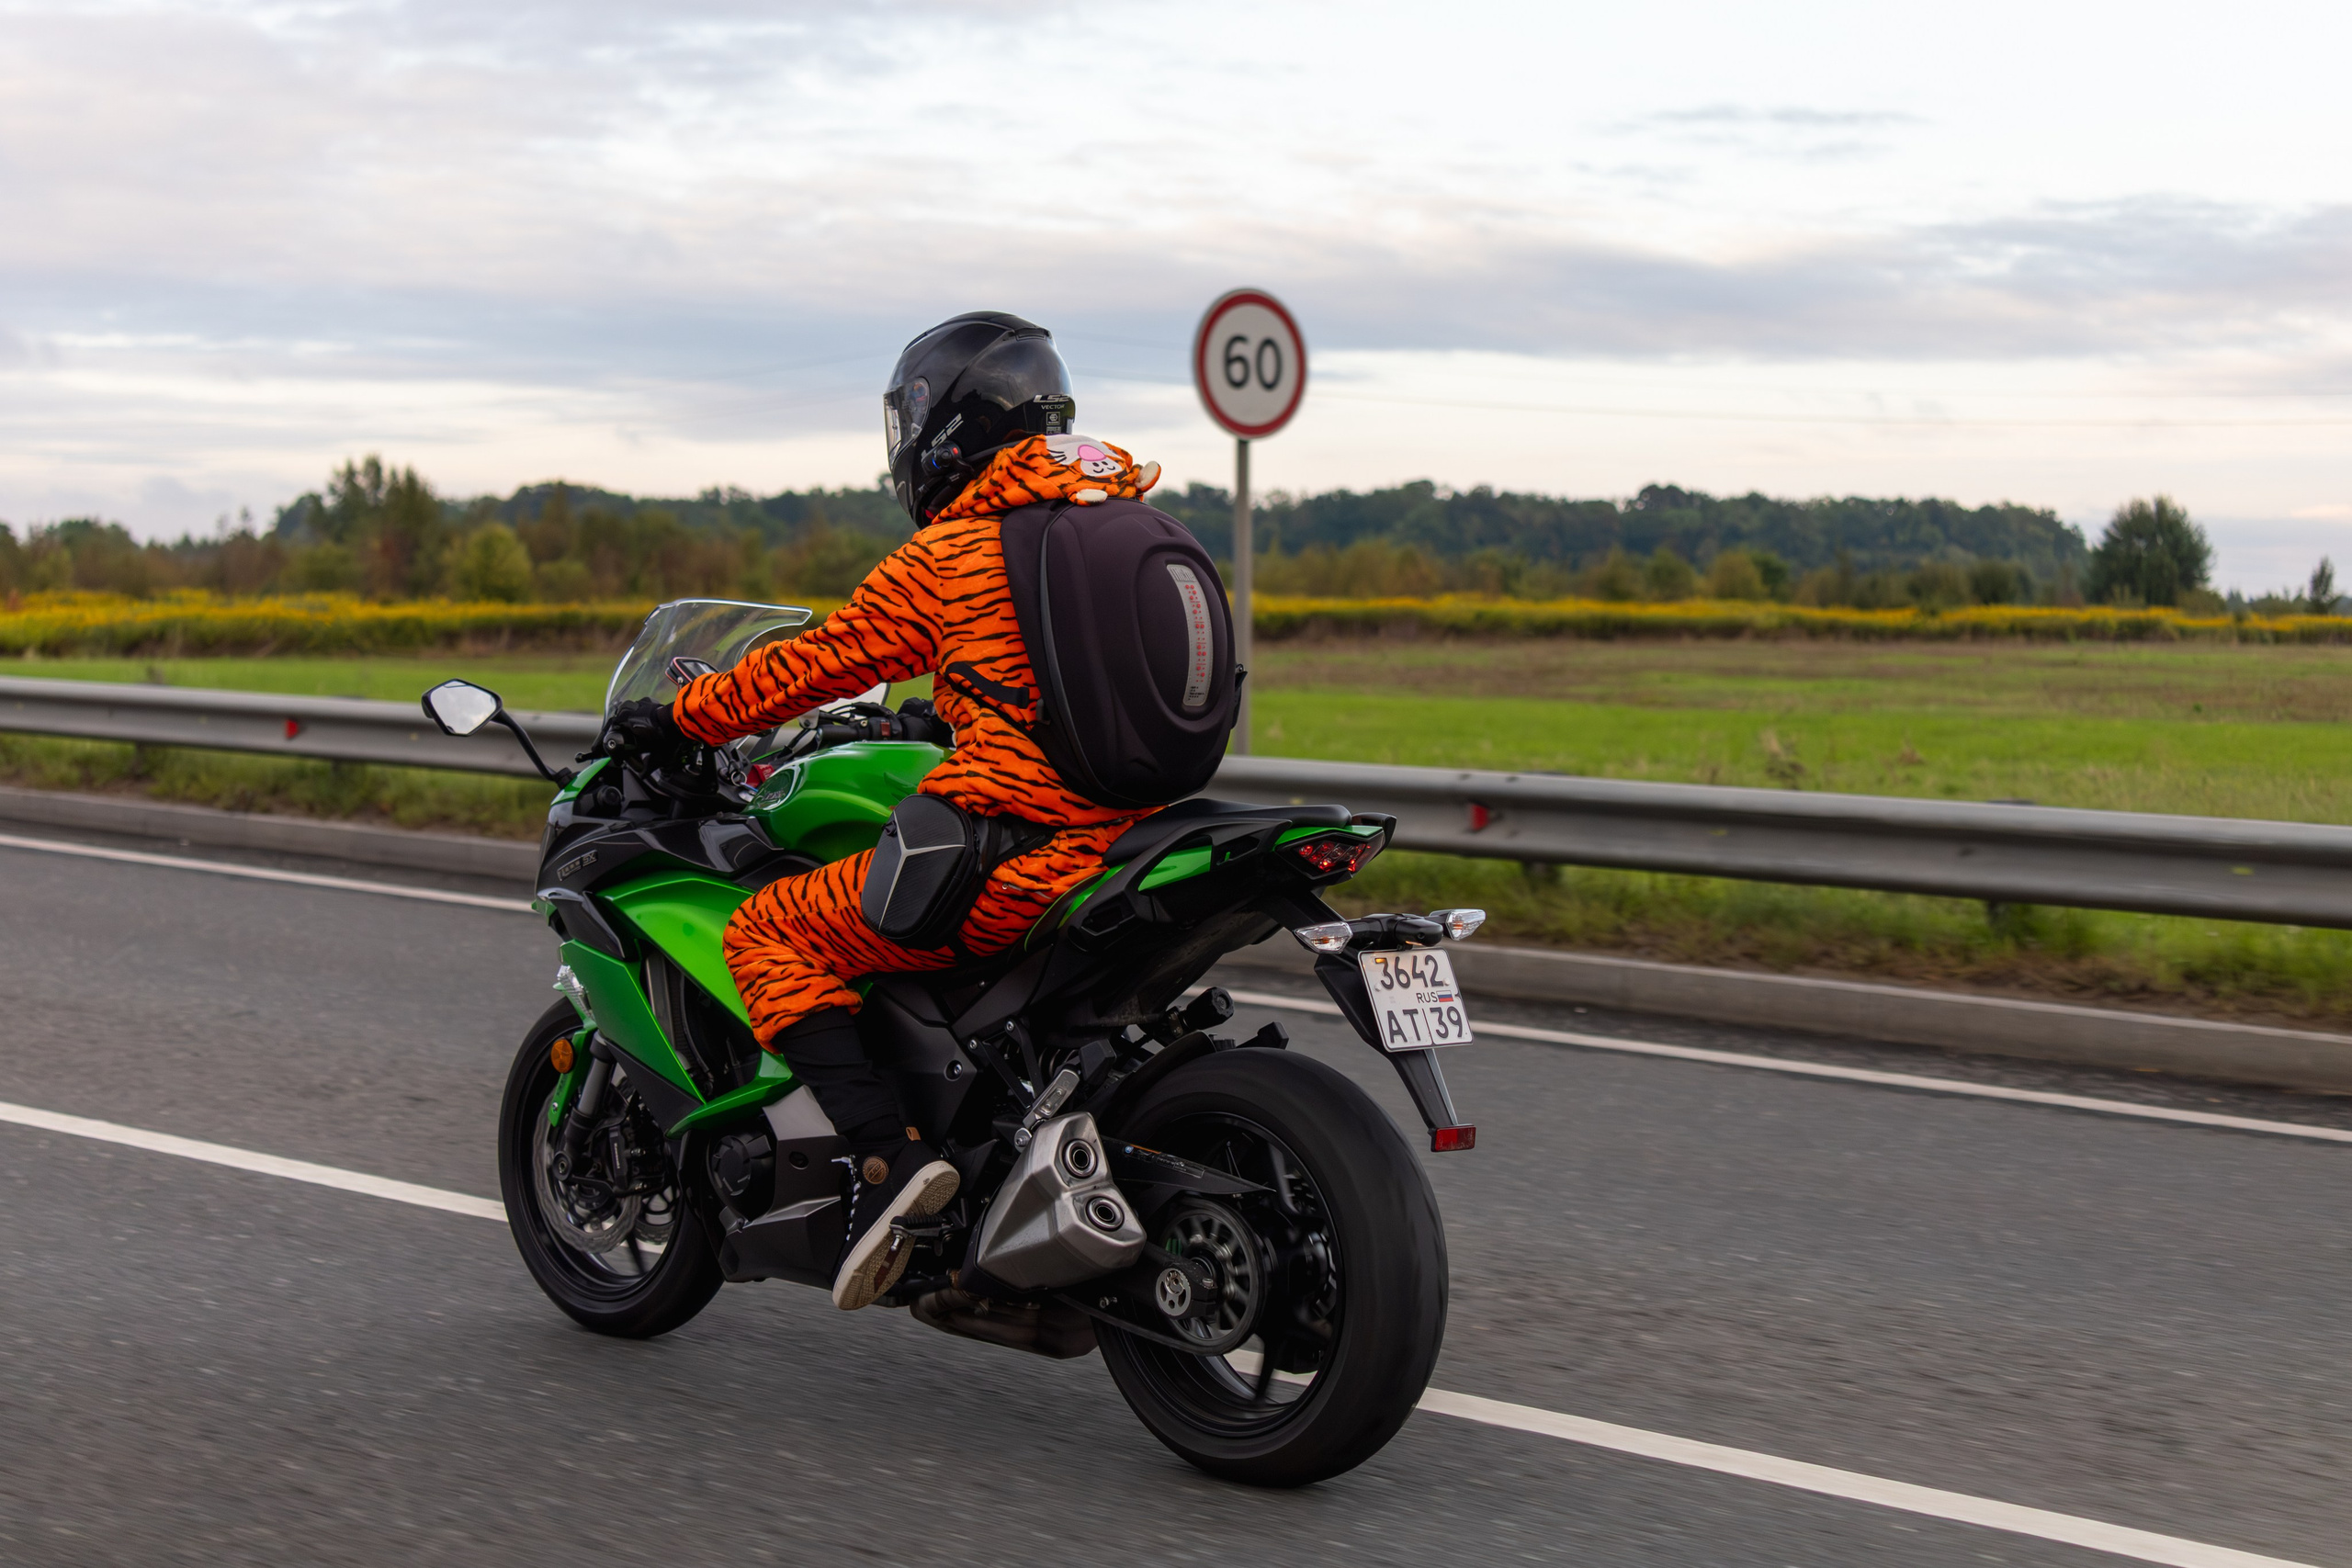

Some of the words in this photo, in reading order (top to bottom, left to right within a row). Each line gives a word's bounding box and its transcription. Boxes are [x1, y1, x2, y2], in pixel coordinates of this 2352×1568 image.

[1224, 334, 1283, 392] 60
[1033, 394, 1069, 403] LS2
[1374, 954, 1444, 990] 3642
[1416, 991, 1439, 1004] RUS
[1386, 1008, 1421, 1043] AT
[1430, 1006, 1464, 1039] 39
